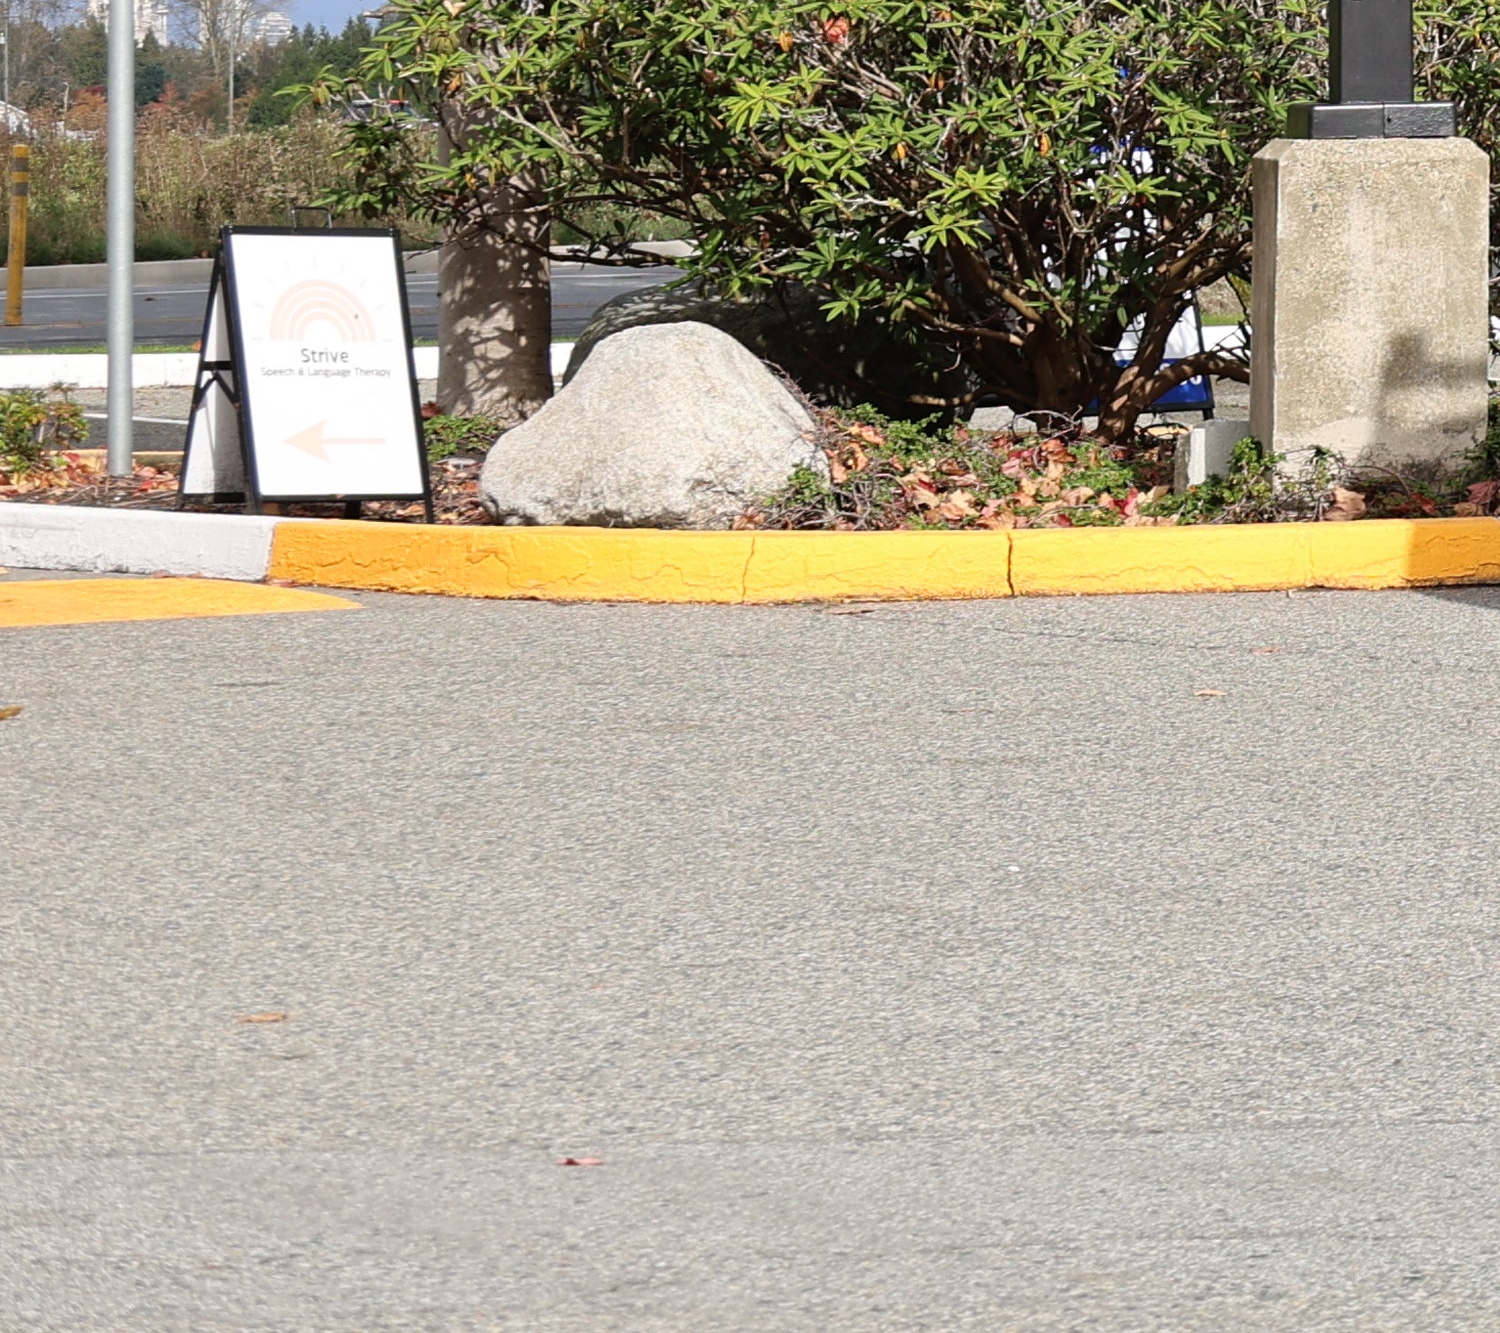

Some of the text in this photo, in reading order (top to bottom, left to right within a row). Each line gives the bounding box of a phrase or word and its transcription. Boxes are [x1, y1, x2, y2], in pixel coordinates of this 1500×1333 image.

[300, 348, 349, 363] Strive
[260, 367, 295, 377] Speech
[307, 367, 351, 378] Language
[354, 367, 392, 378] Therapy
